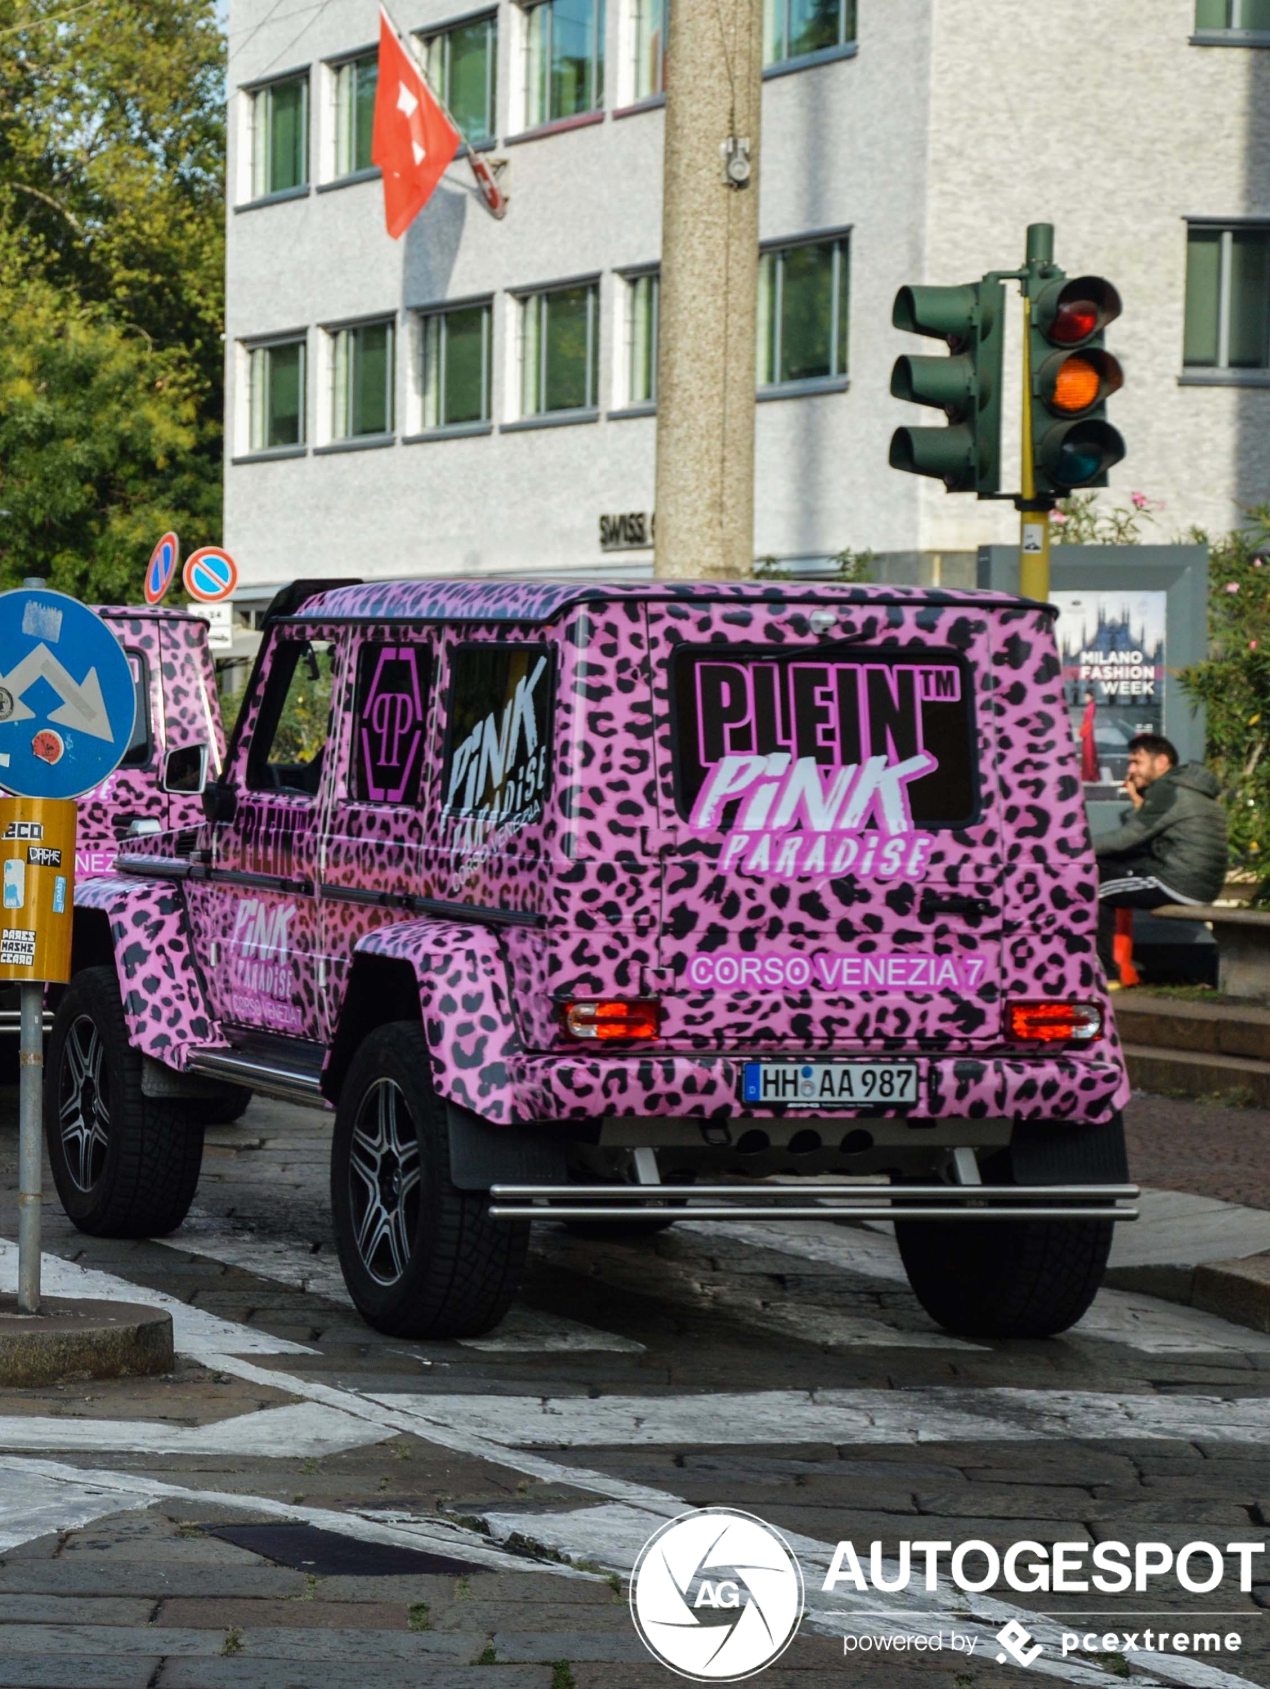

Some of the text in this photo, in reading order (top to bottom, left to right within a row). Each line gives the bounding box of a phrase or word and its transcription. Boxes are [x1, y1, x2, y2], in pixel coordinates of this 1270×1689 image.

[599, 512, 646, 545] SWISS
[1081, 650, 1143, 665] MILANO
[1081, 666, 1155, 679] FASHION
[1101, 681, 1155, 695] WEEK
[690, 956, 984, 987] CORSO VENEZIA 7
[763, 1069, 798, 1098] HH
[819, 1069, 854, 1098] AA
[861, 1069, 912, 1098] 987
